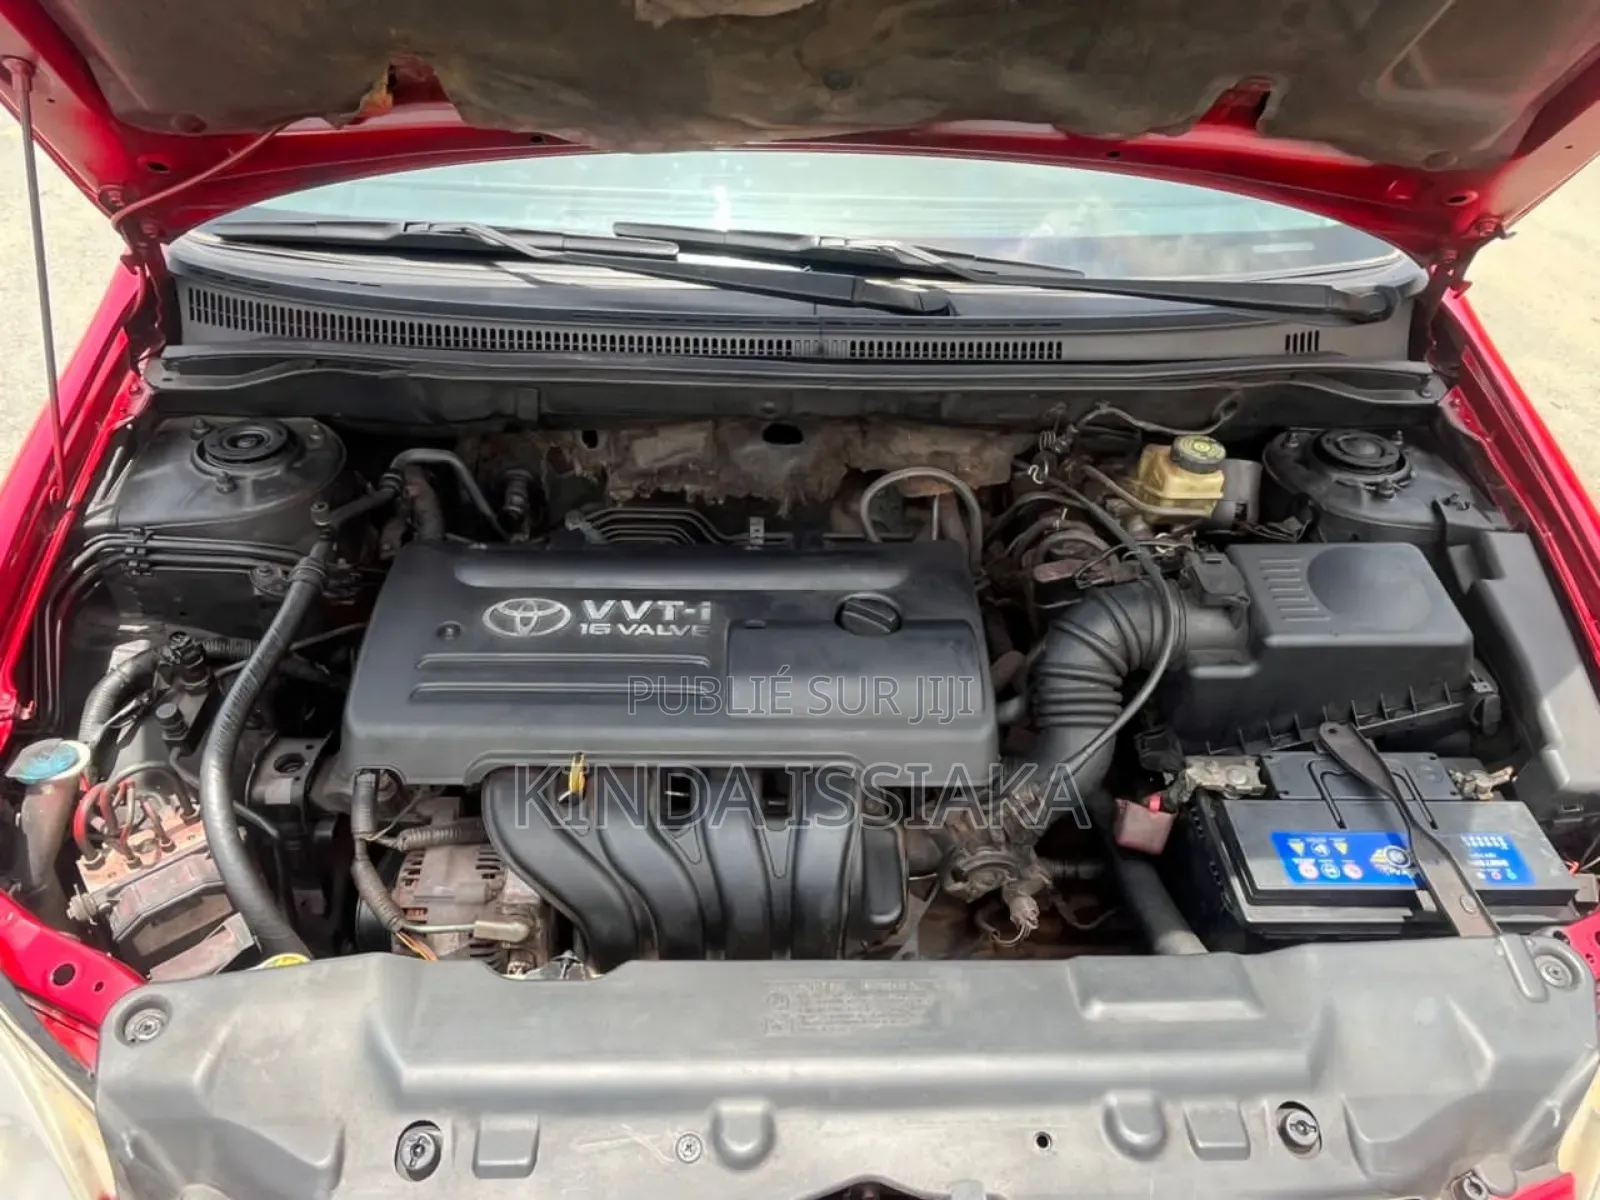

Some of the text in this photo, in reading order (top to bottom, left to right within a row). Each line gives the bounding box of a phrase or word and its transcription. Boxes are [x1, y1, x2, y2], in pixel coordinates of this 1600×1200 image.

[582, 599, 711, 621] VVT-i
[580, 623, 710, 637] 16 VALVE
